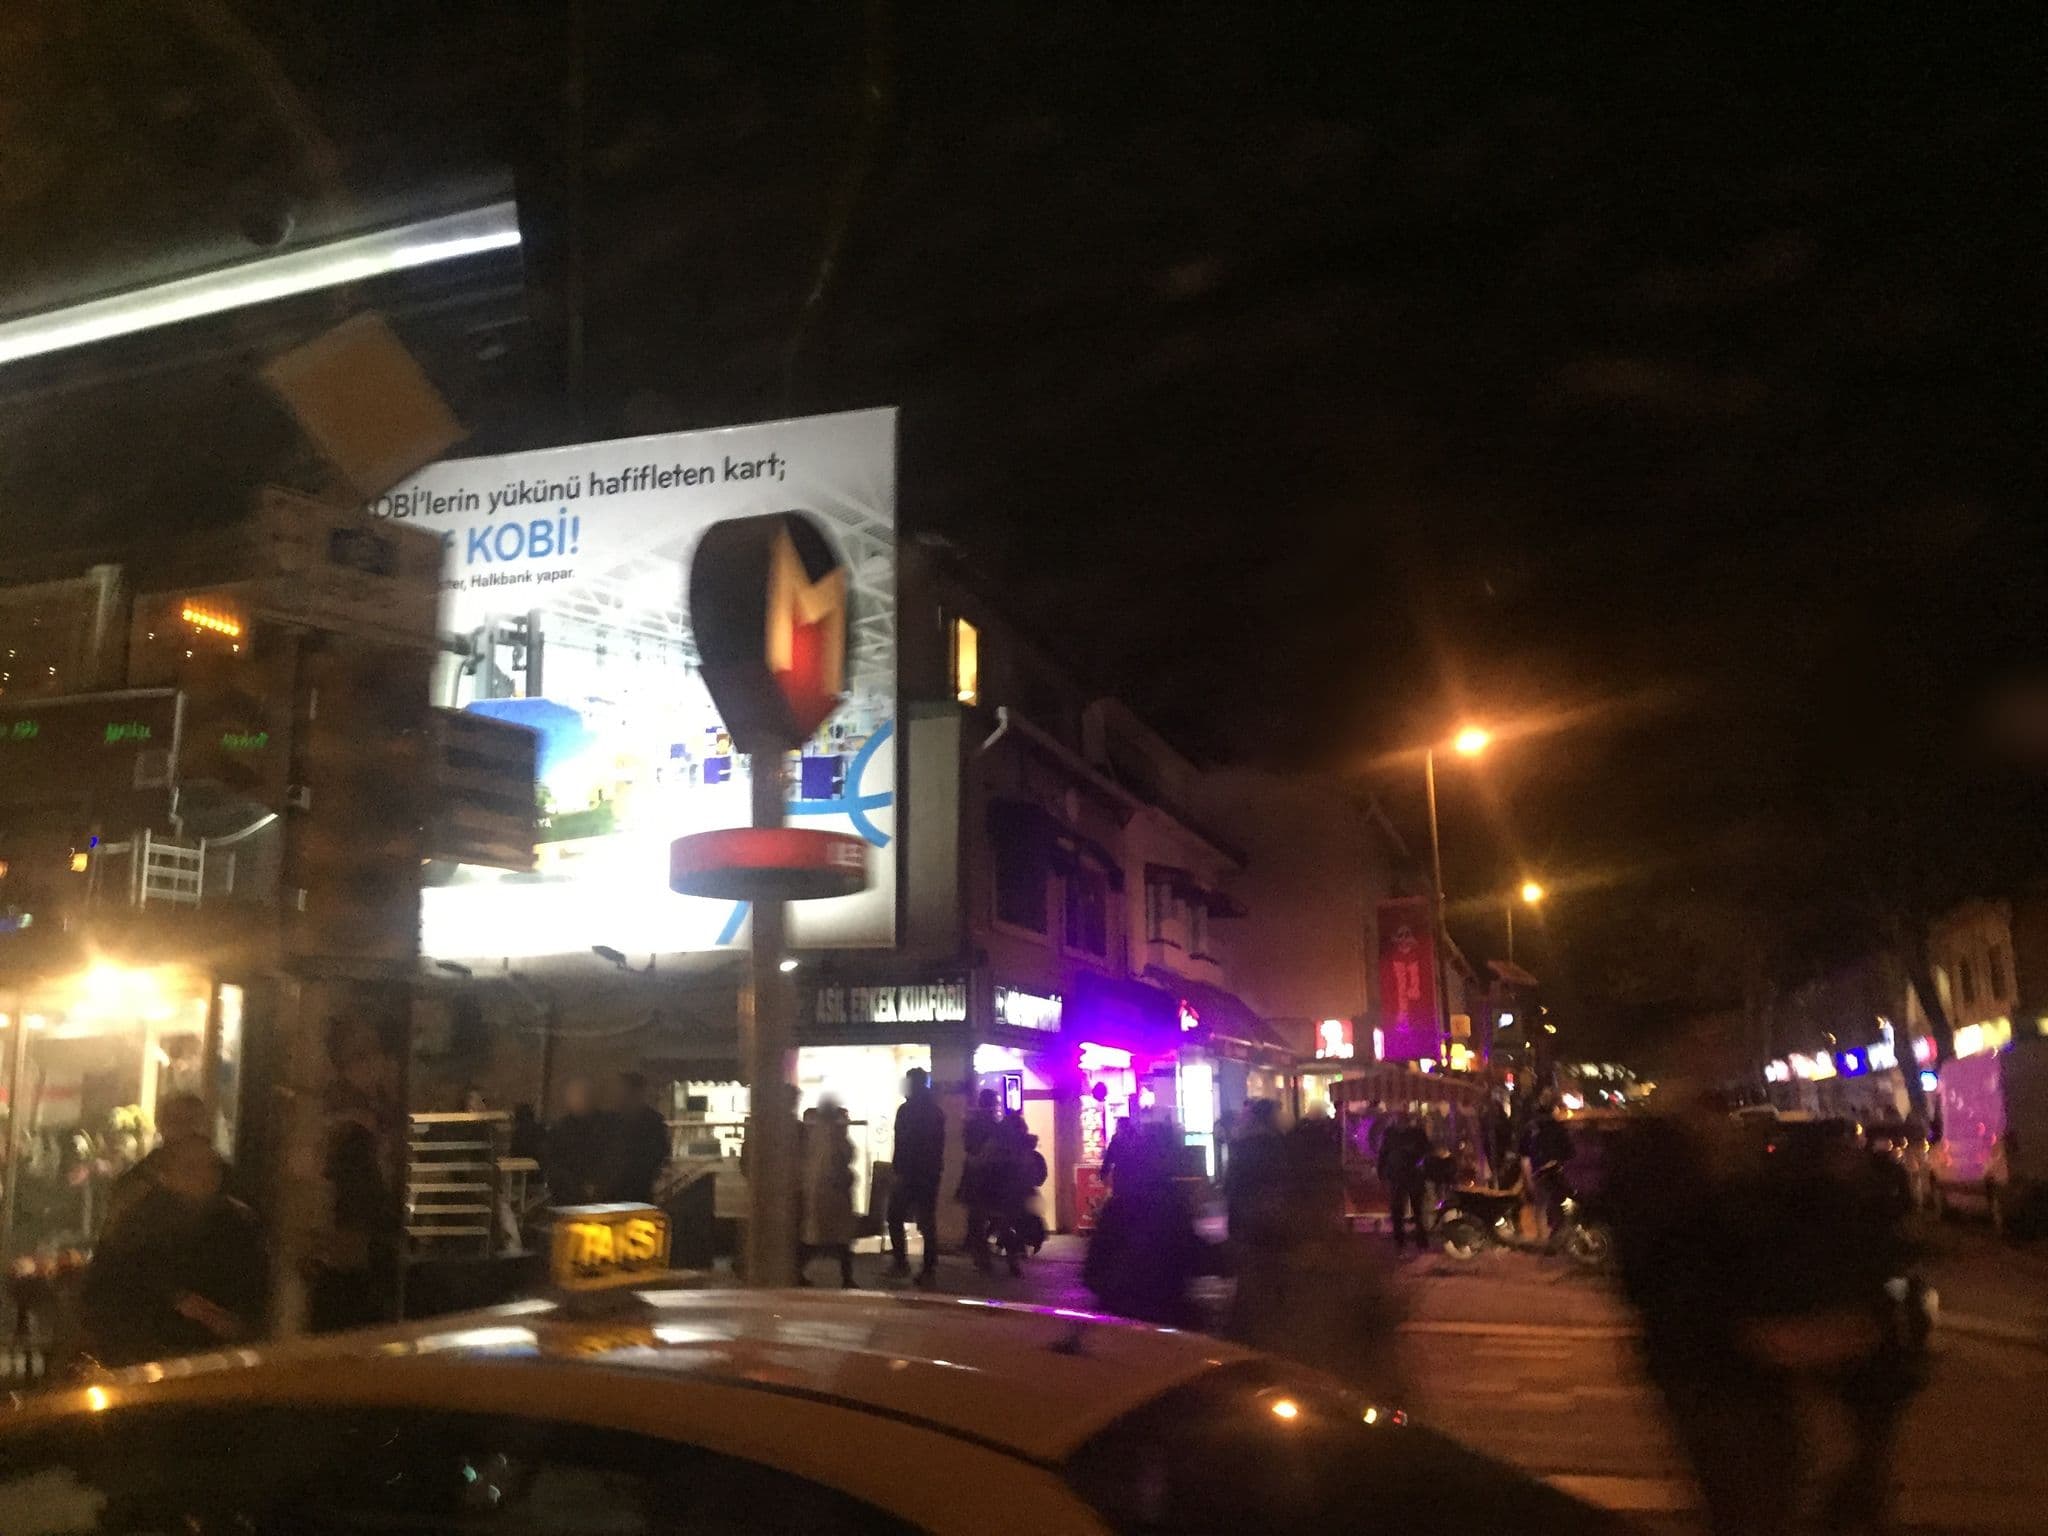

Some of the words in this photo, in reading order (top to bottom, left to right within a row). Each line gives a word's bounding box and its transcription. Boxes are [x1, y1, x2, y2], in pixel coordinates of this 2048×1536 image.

[372, 485, 480, 520] OBİ'lerin
[488, 476, 581, 514] yükünü
[589, 464, 716, 497] hafifleten
[724, 452, 787, 483] kart;
[466, 507, 580, 565] KOBİ!
[471, 569, 534, 588] Halkbank
